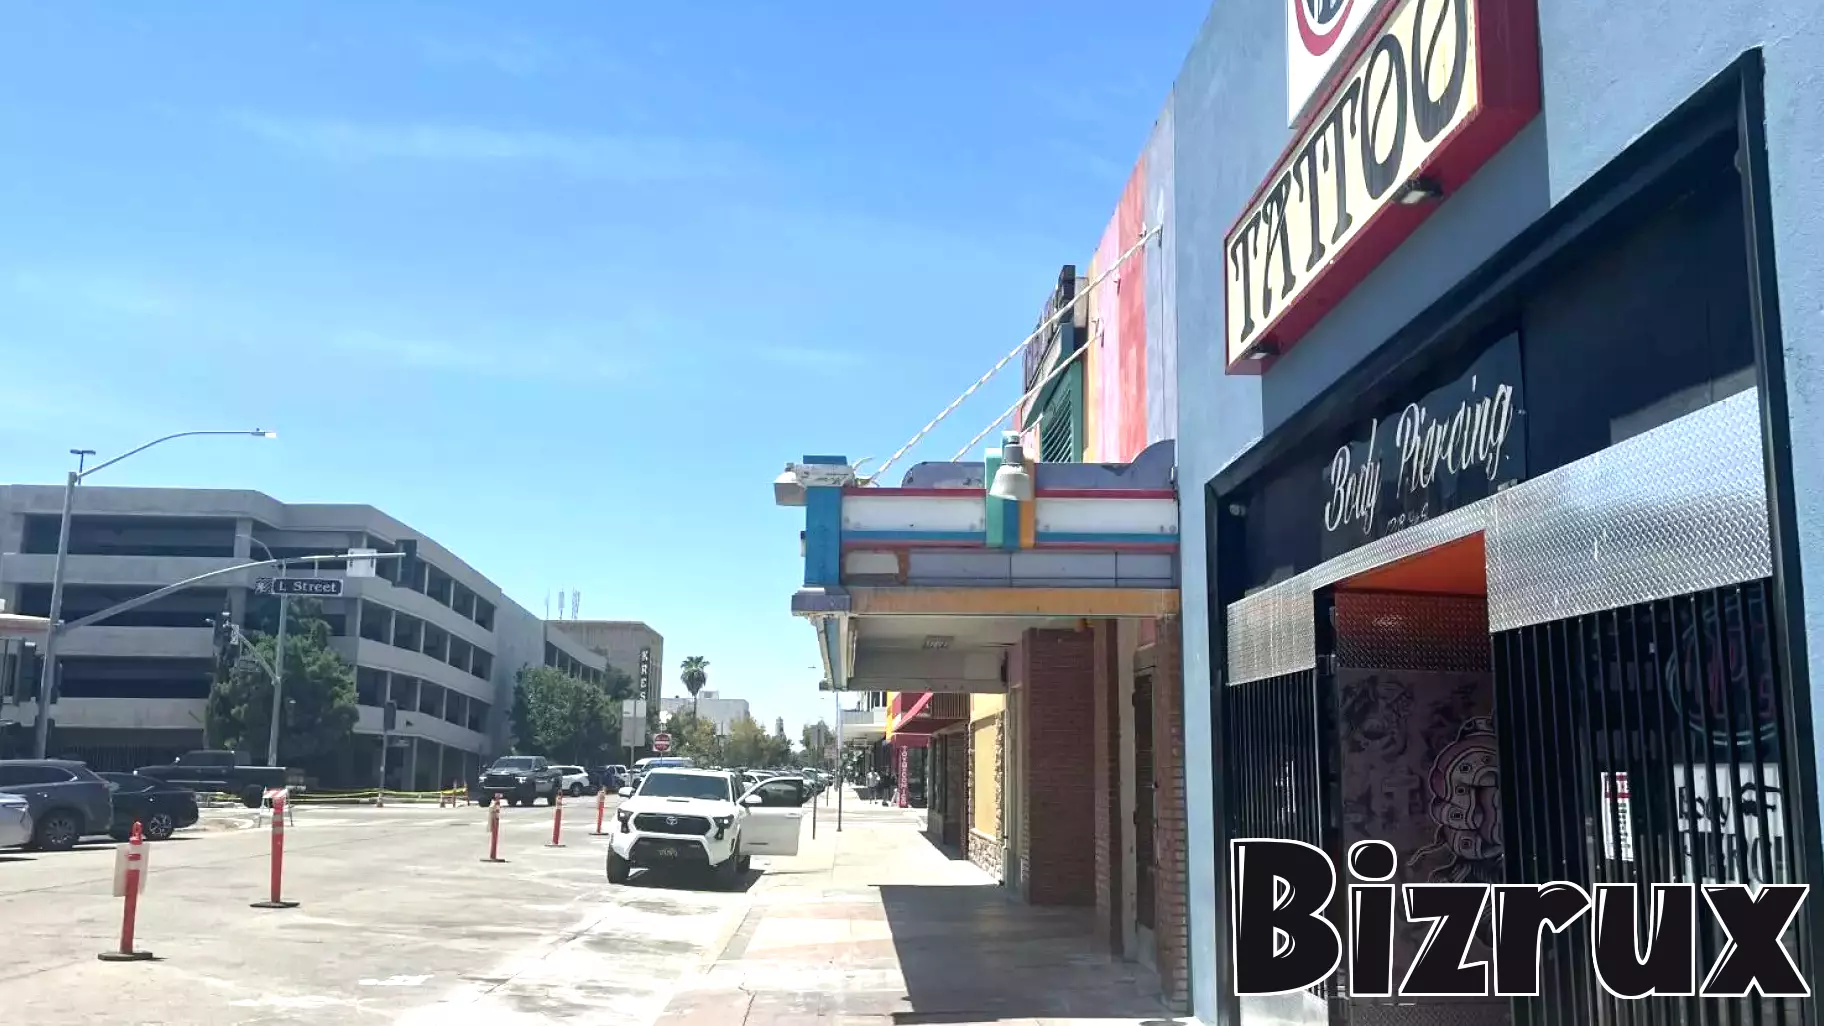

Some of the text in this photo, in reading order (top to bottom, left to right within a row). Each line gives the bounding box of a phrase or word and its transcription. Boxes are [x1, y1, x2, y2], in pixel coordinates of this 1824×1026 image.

[1231, 0, 1467, 343] TATTOO
[1324, 374, 1513, 535] Body Piercing
[279, 581, 337, 593] L Street
